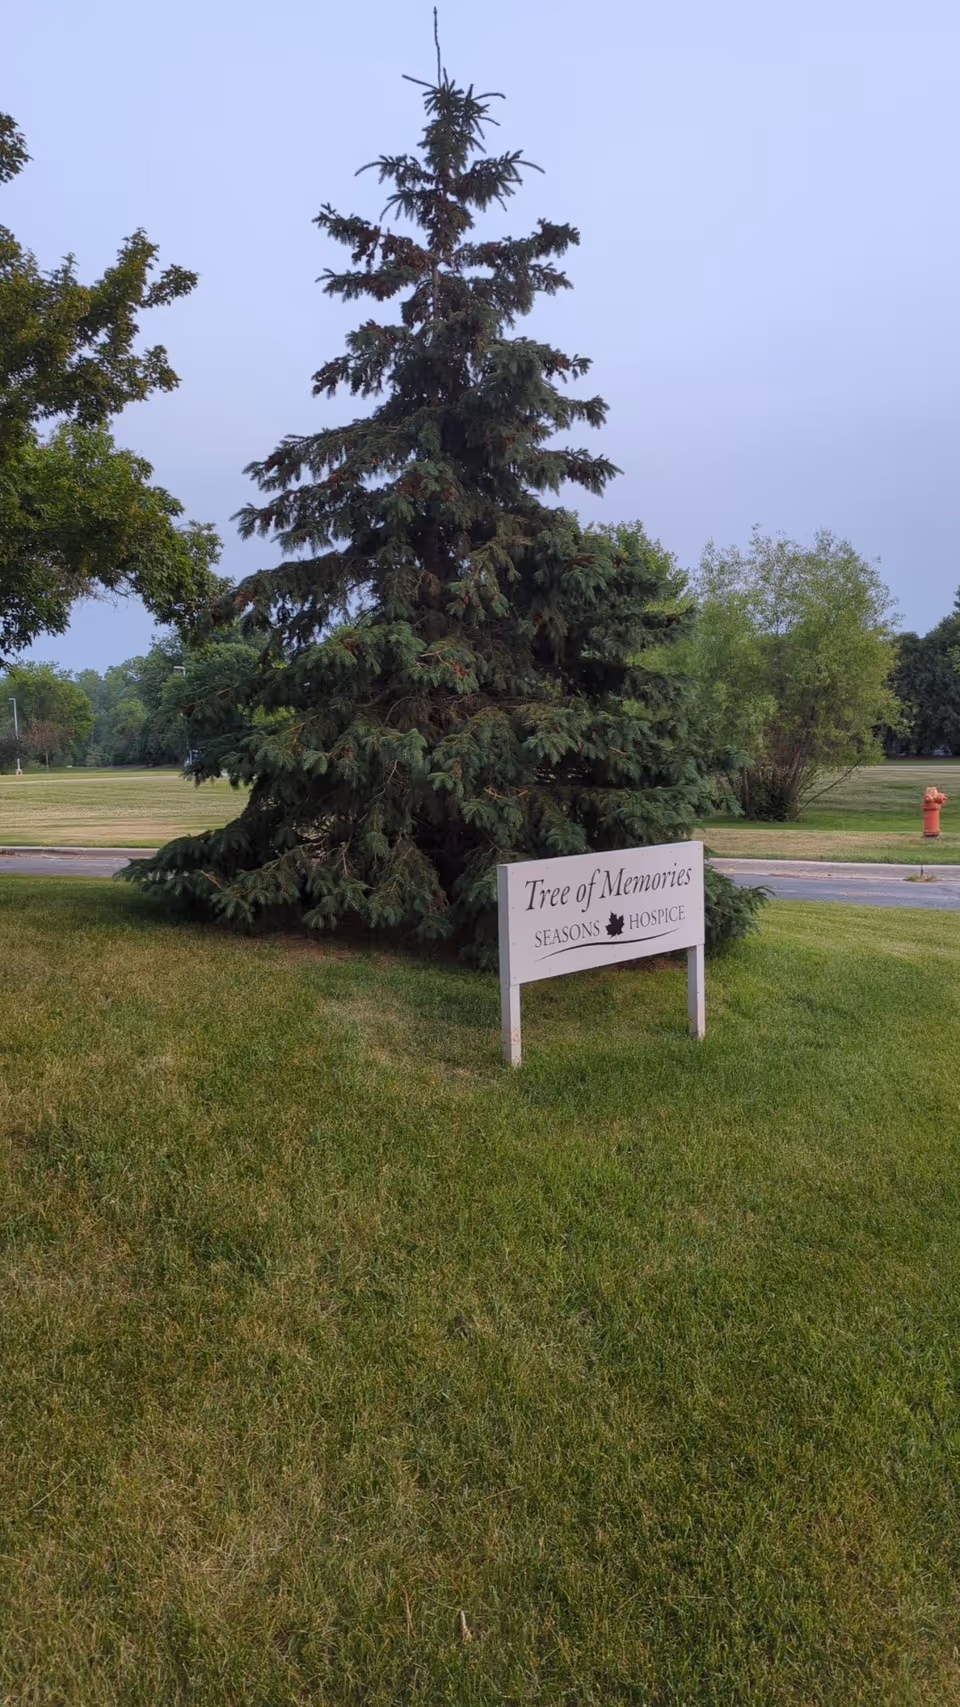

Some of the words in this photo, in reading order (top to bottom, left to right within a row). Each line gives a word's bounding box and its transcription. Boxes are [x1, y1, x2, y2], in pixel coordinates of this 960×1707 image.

[525, 878, 571, 911] Tree
[576, 868, 601, 913] of
[598, 862, 692, 899] Memories
[534, 920, 600, 948] SEASONS
[629, 905, 686, 930] HOSPICE
